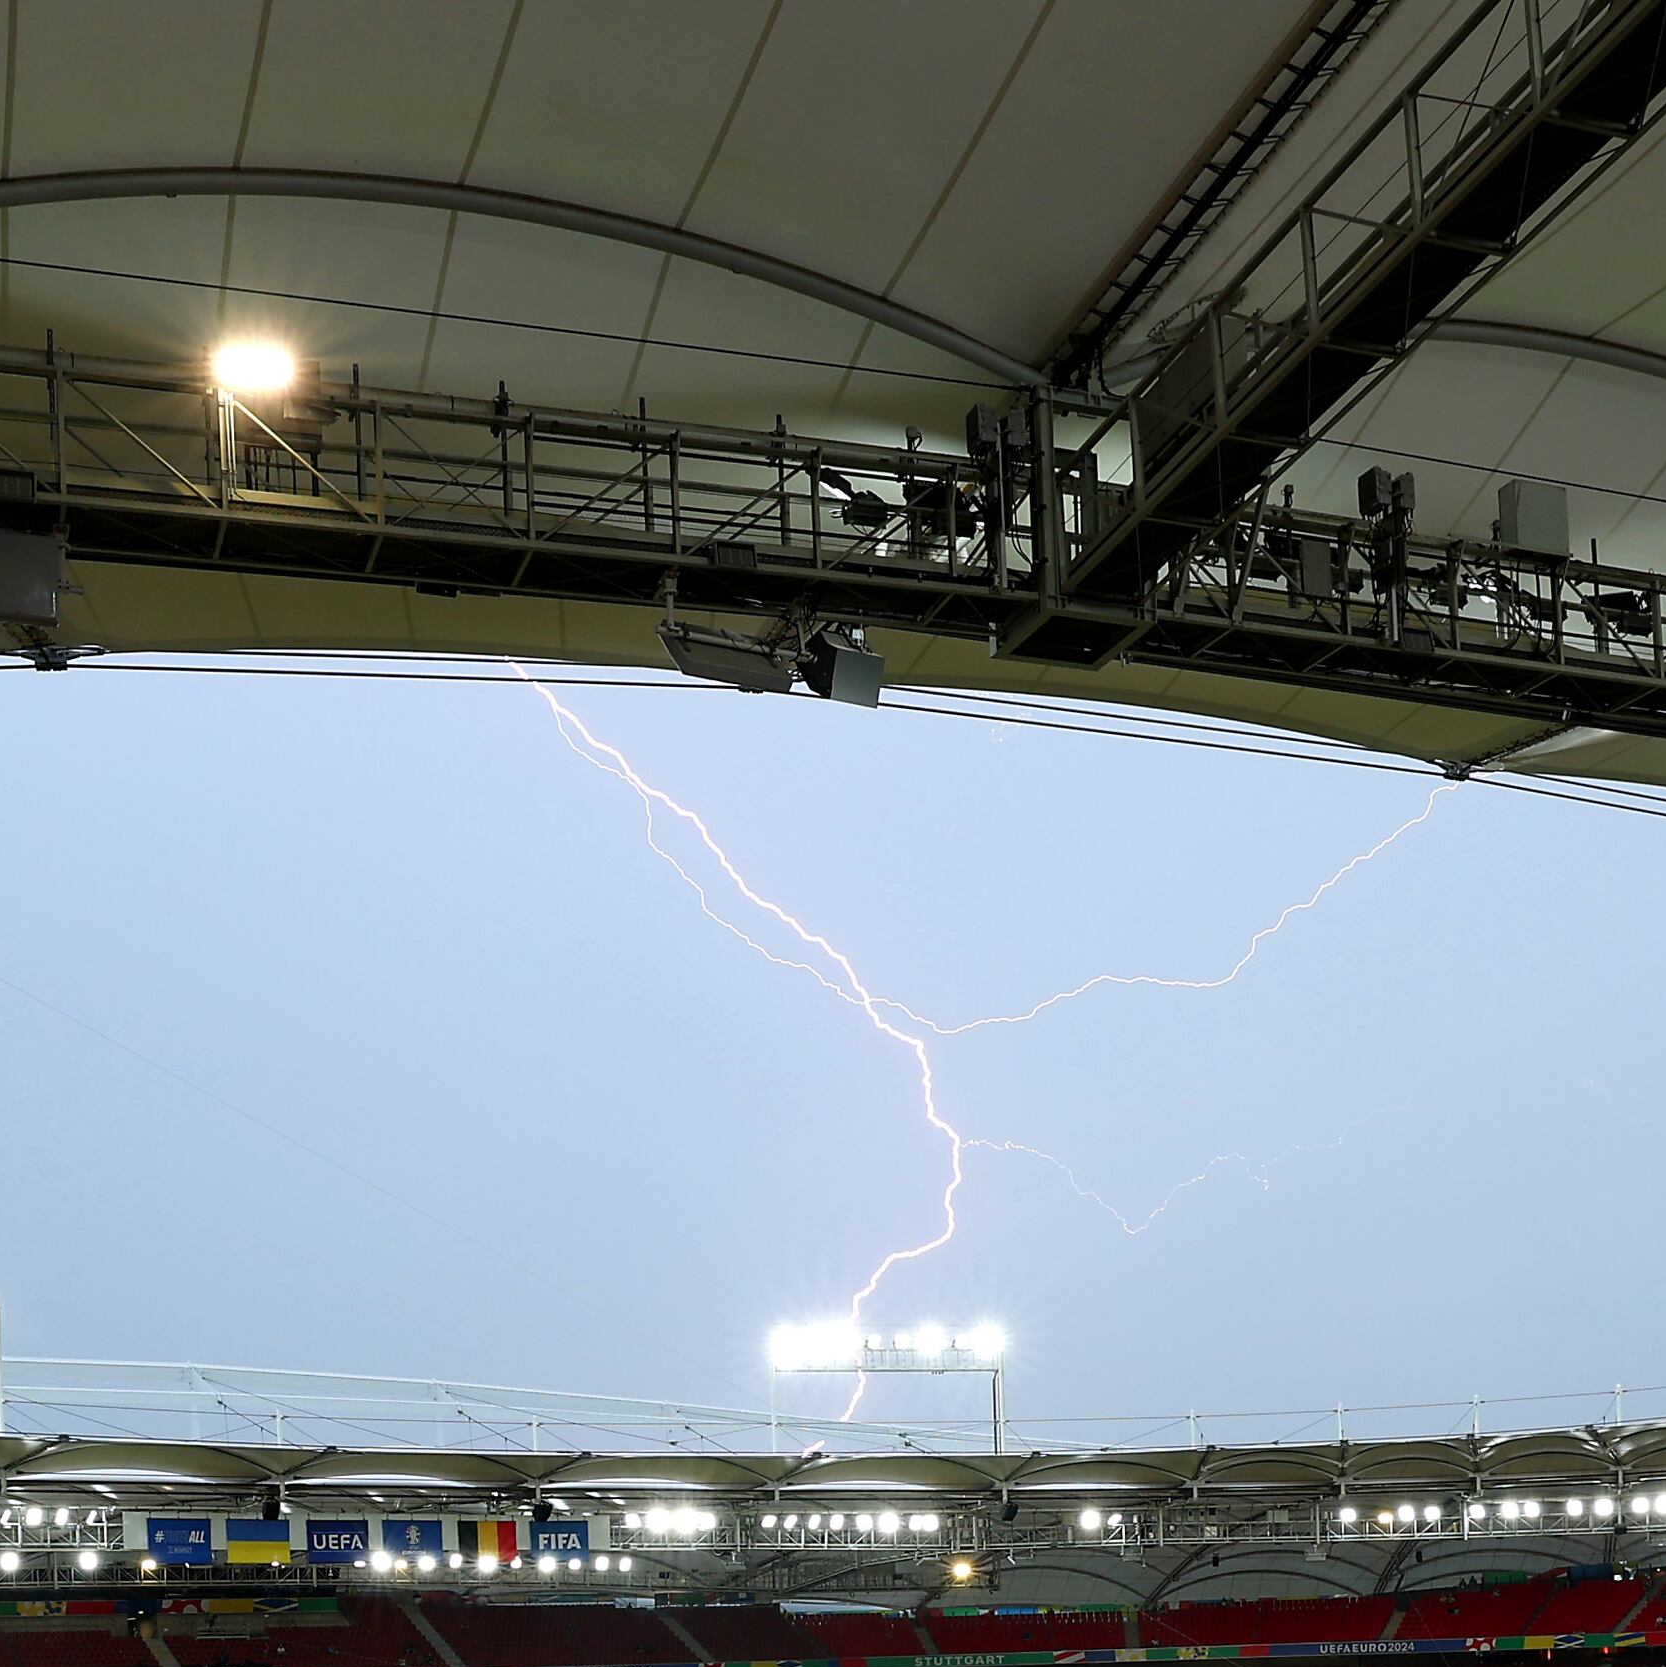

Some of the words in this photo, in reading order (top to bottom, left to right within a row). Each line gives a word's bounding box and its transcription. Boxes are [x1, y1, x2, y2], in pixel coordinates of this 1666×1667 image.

[312, 1533, 364, 1550] UEFA
[538, 1533, 582, 1550] FIFA
[914, 1655, 1005, 1667] STUTTGART
